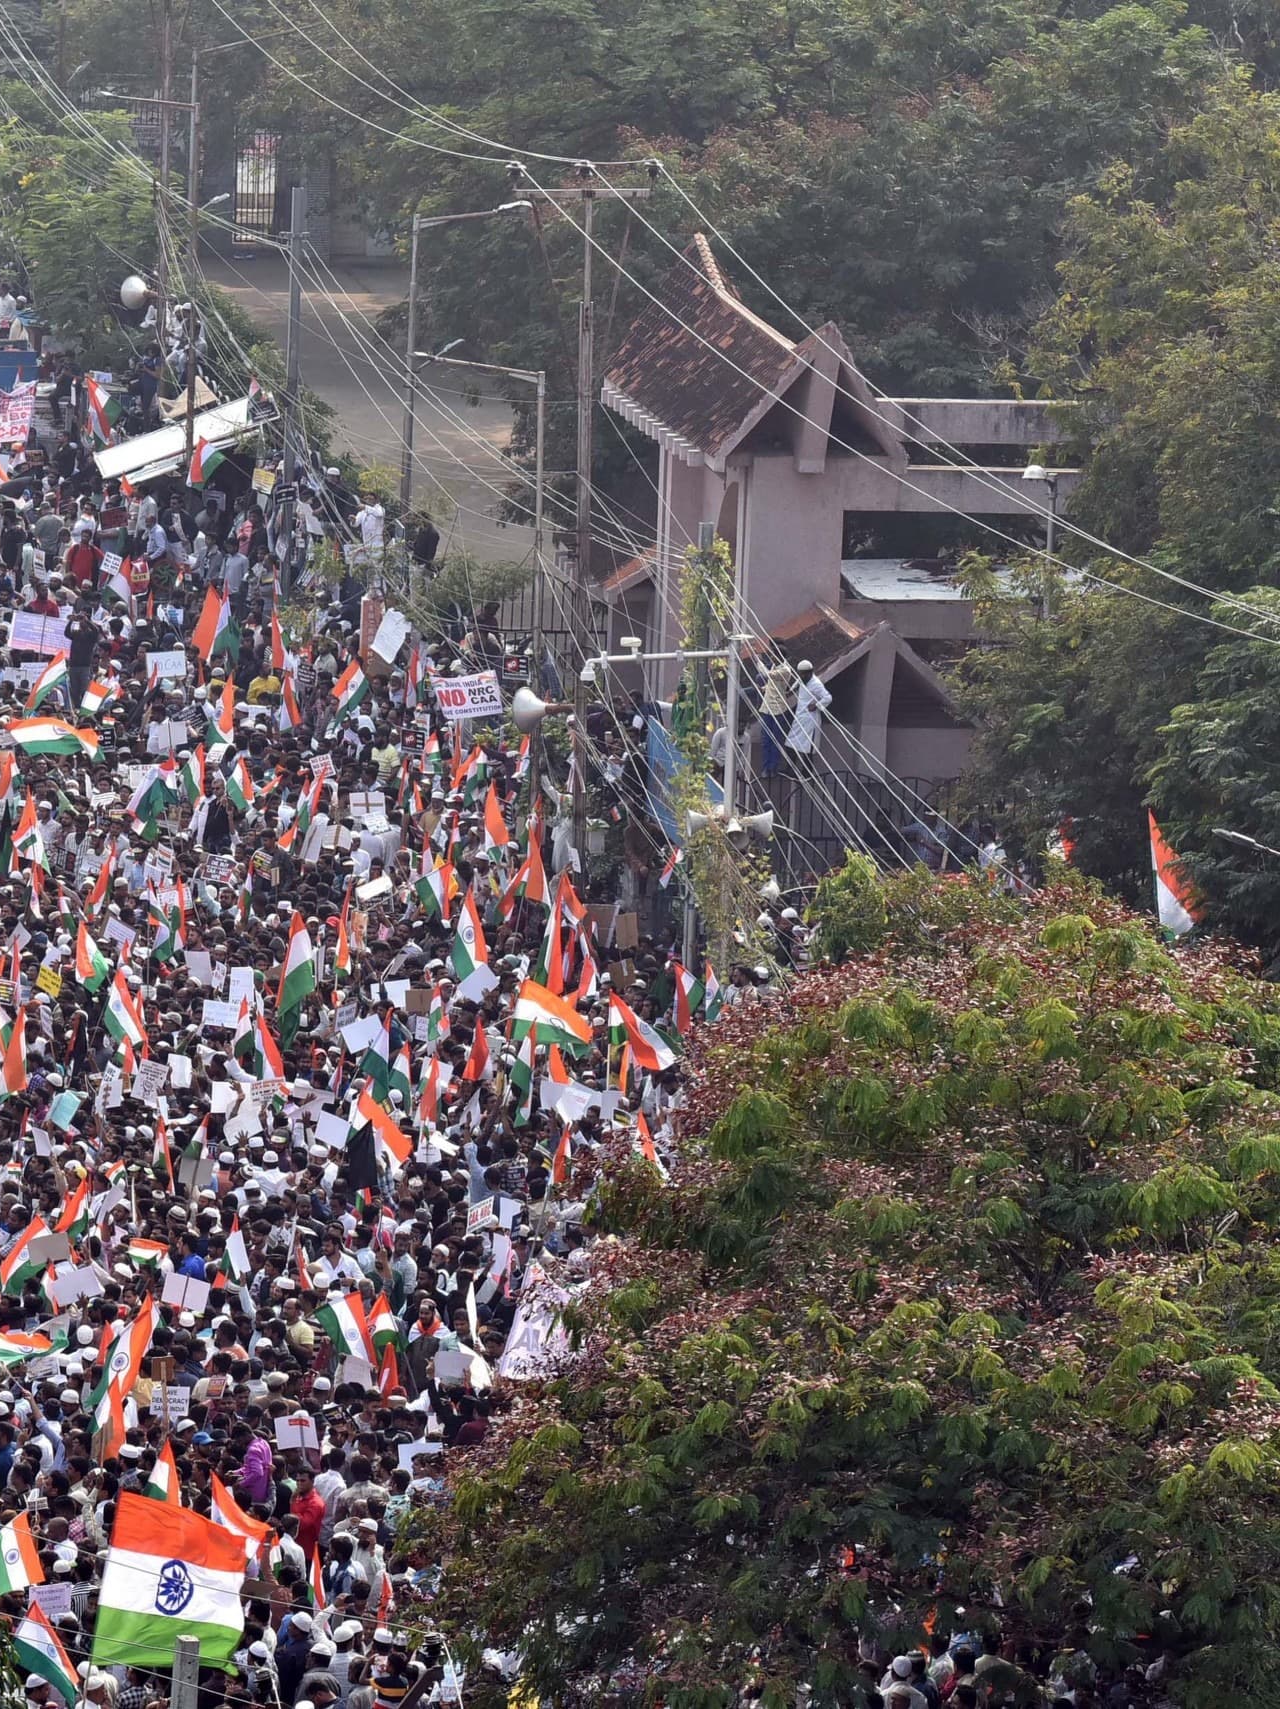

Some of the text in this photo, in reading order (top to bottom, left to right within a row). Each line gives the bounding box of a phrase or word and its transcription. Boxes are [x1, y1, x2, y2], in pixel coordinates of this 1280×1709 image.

[462, 679, 483, 688] INDIA
[437, 686, 495, 707] NO NRC
[470, 696, 498, 705] CAA
[454, 705, 502, 715] CONSTITUTION
